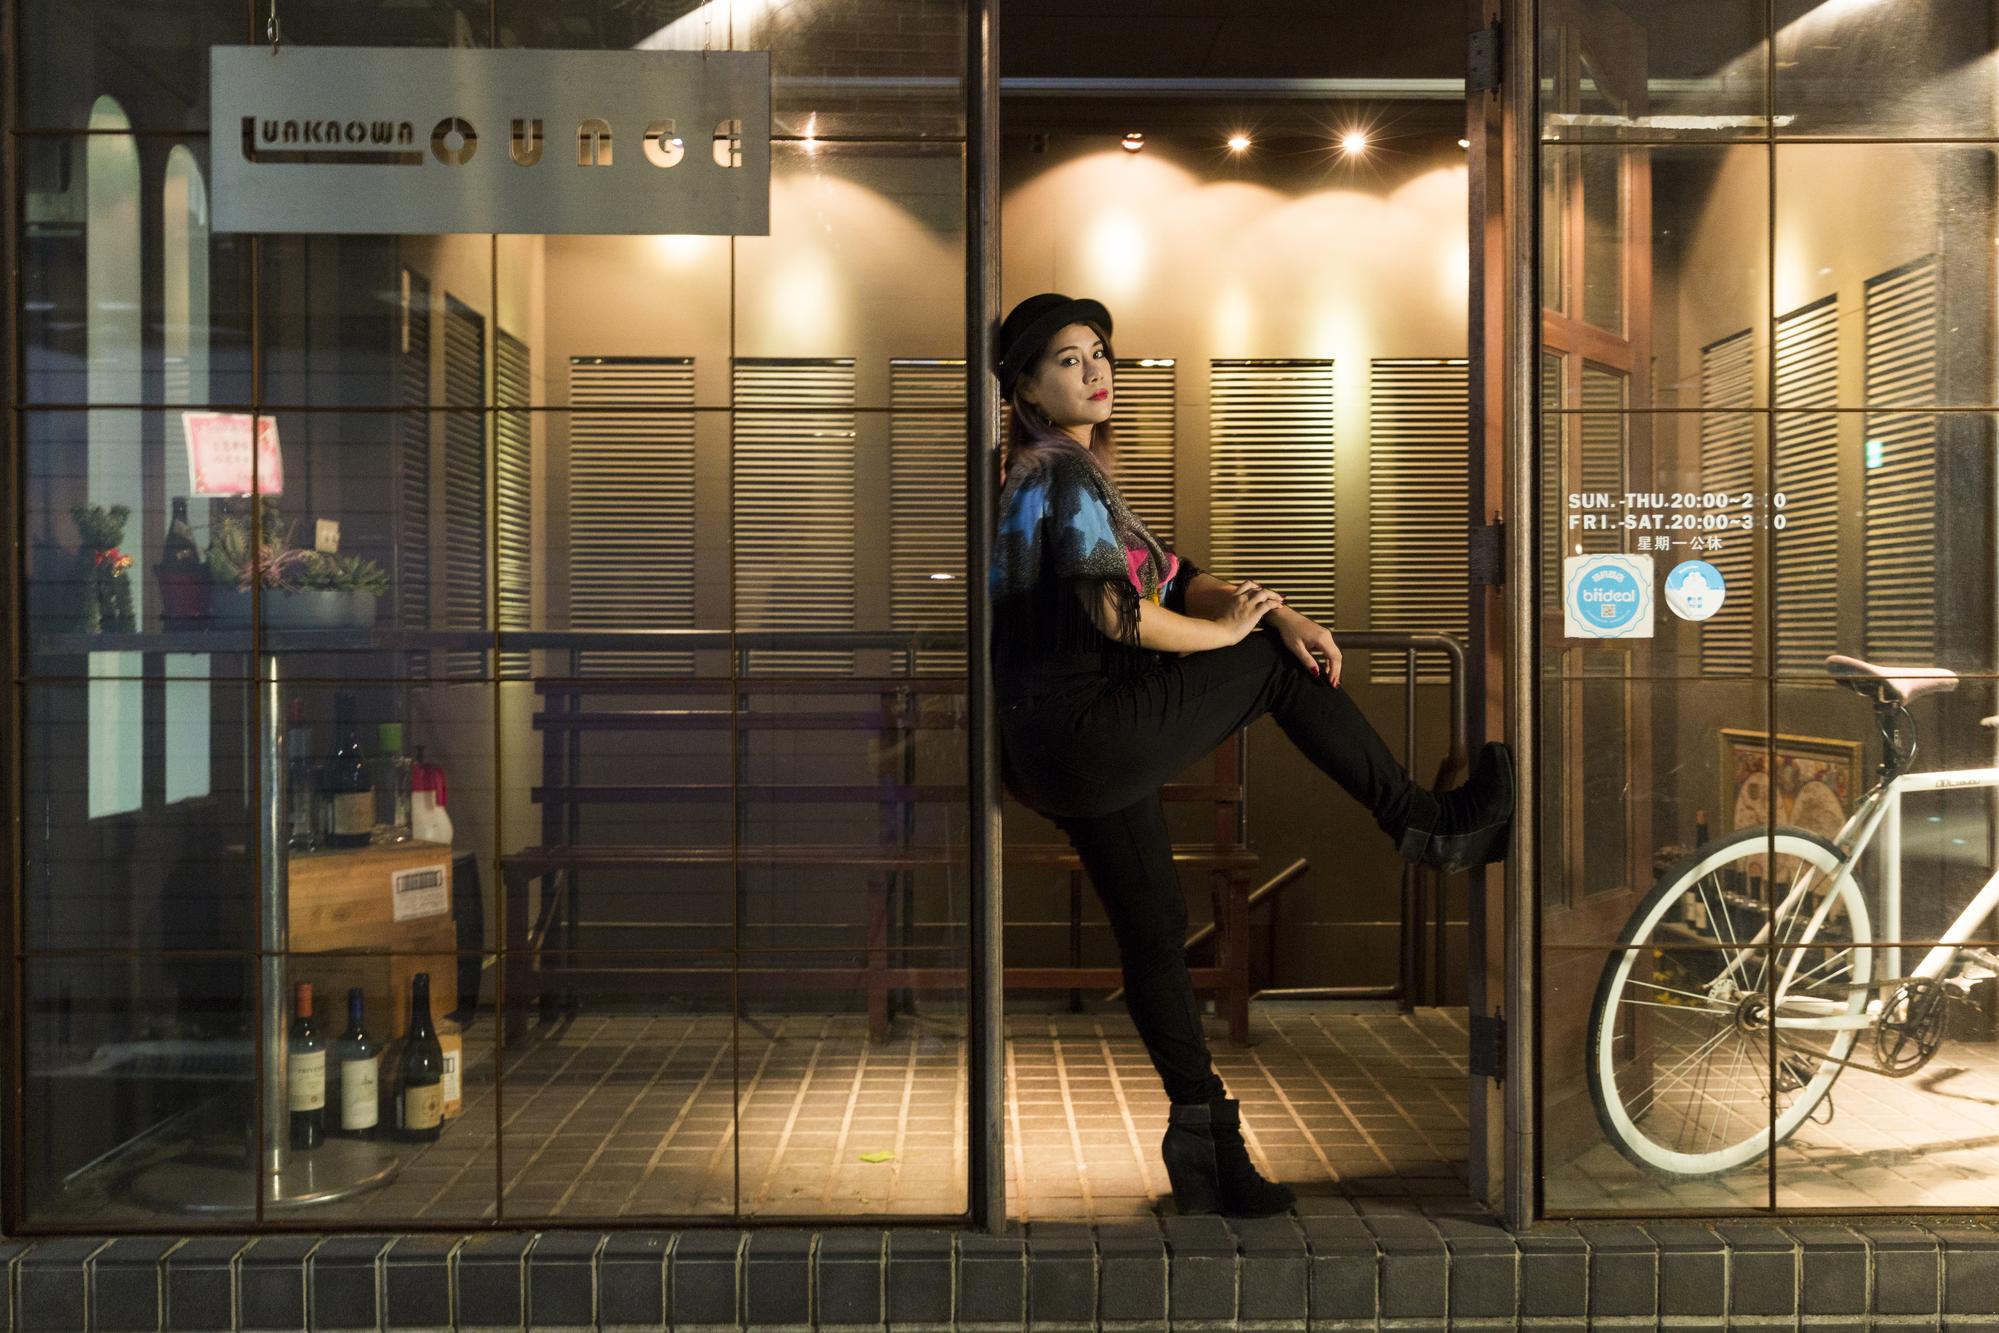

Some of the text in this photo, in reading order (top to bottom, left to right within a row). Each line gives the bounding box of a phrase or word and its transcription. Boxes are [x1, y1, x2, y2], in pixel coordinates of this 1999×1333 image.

[1637, 536, 1723, 551] 星期一公休
